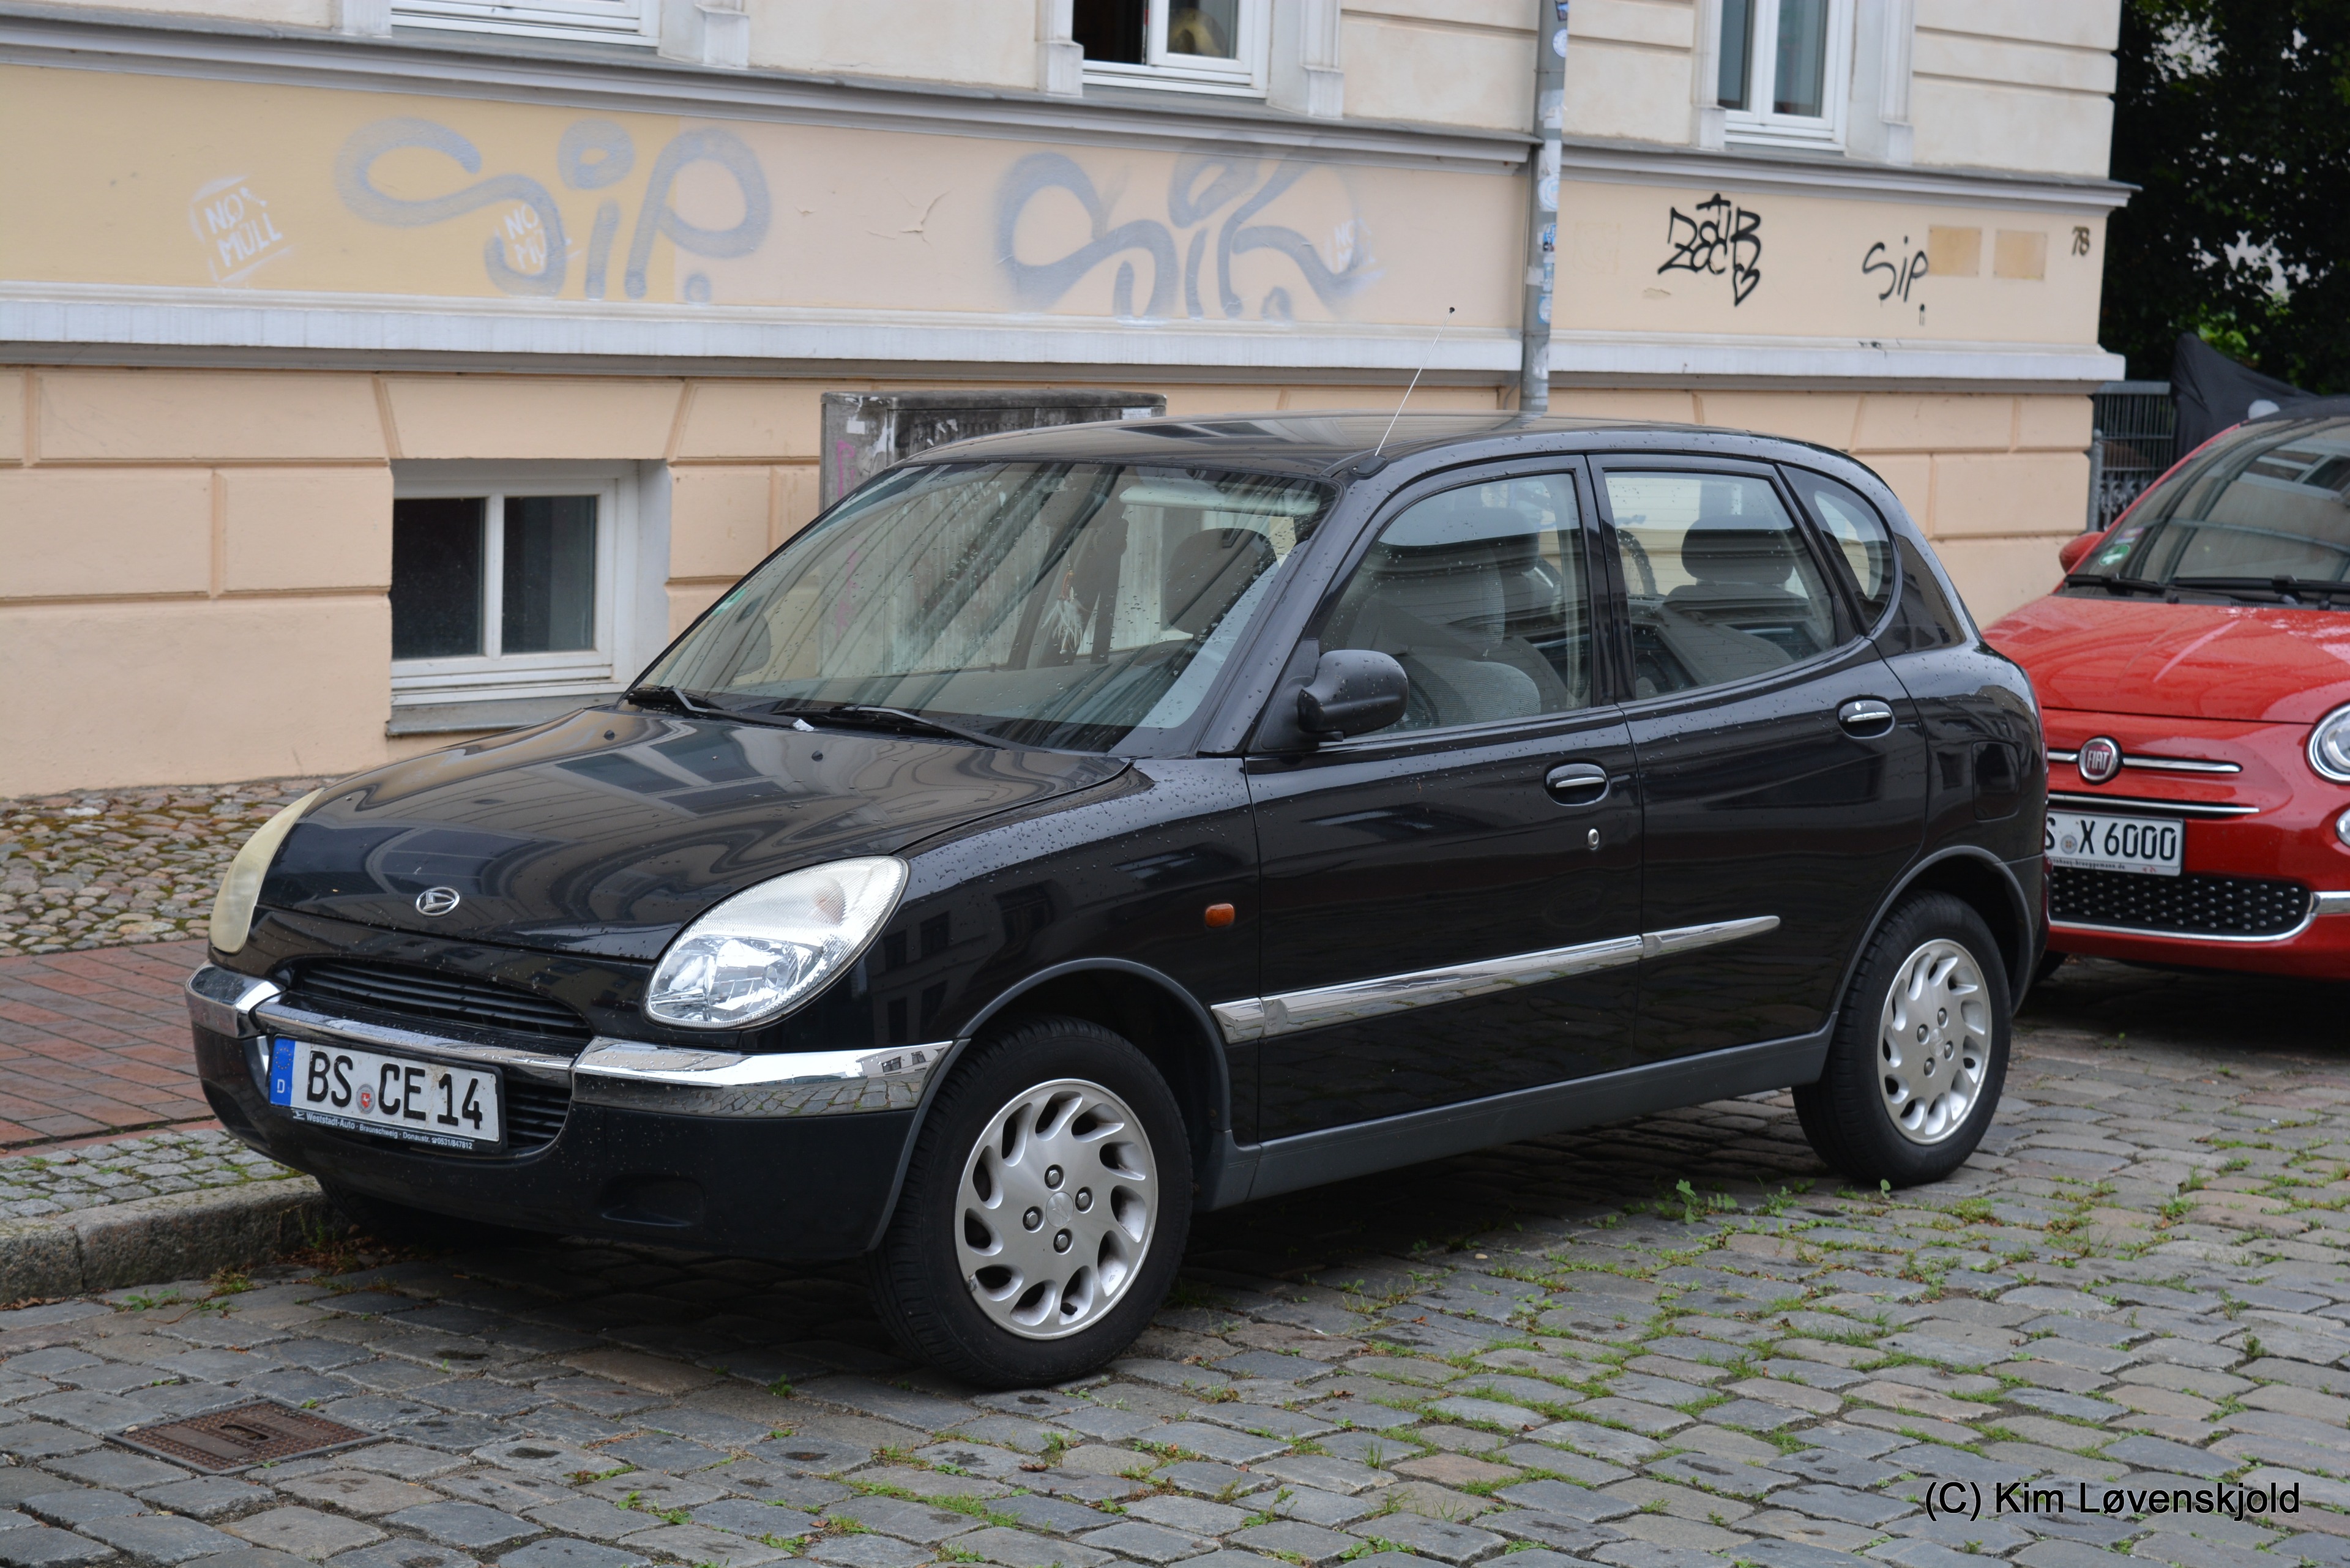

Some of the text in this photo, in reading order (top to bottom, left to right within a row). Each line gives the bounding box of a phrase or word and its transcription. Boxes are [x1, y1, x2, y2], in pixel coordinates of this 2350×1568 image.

[2087, 750, 2109, 771] FIAT
[2045, 817, 2056, 850] S
[2079, 819, 2095, 854] X
[2104, 823, 2177, 861] 6000
[277, 1079, 285, 1094] D
[307, 1050, 354, 1108] BS
[378, 1062, 427, 1121] CE
[437, 1073, 483, 1130] 14
[306, 1112, 472, 1150] Weststadt-Auto Braunschweig Donaustr. 0531/847812
